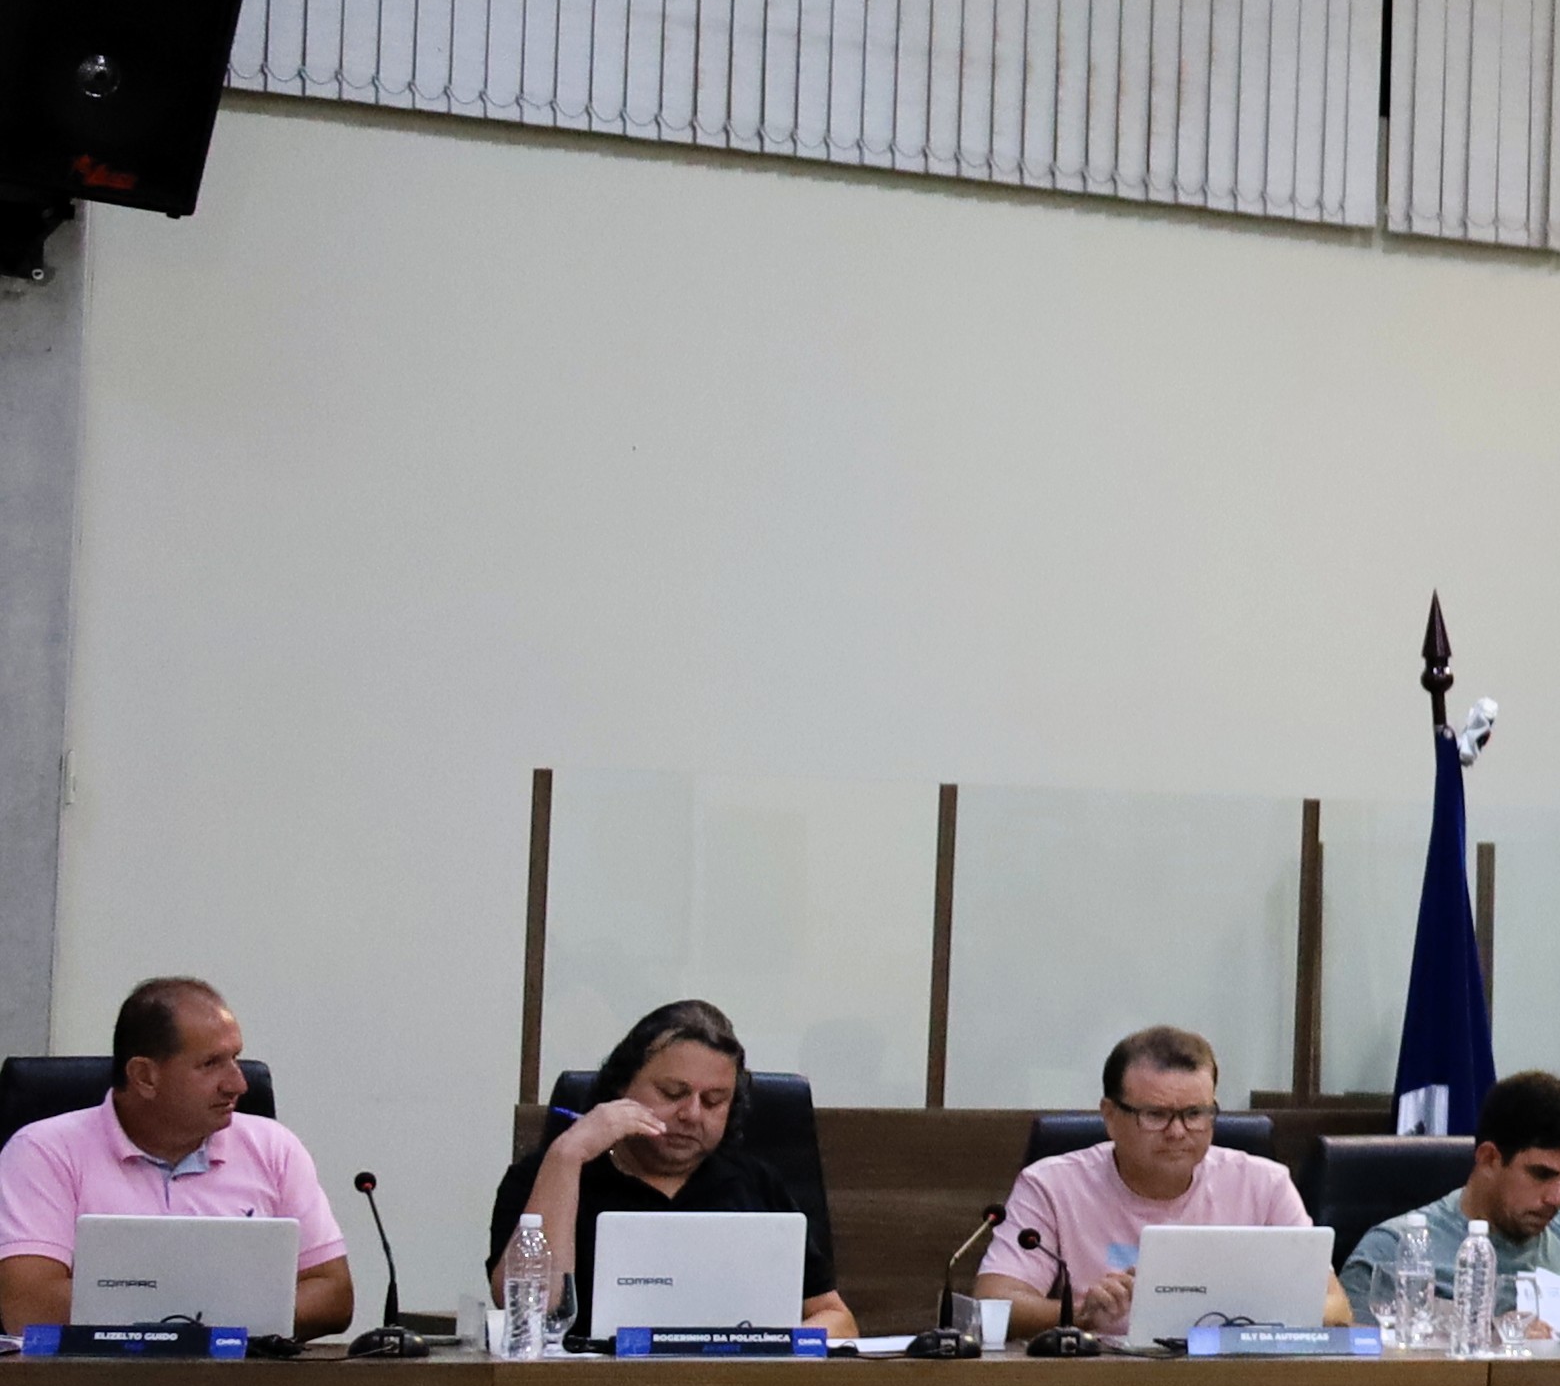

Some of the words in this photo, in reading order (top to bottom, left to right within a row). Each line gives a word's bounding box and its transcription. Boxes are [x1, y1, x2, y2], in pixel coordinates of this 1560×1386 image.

[97, 1279, 157, 1289] COMPAQ
[617, 1277, 673, 1286] COMPAQ
[1155, 1285, 1207, 1294] COMPAQ
[94, 1331, 143, 1341] ELIZELTO
[144, 1332, 179, 1341] GUIDO
[653, 1333, 712, 1342] ROGERINHO
[713, 1333, 728, 1342] DA
[729, 1331, 791, 1343] POLICLÍNICA
[1259, 1333, 1274, 1341] DA
